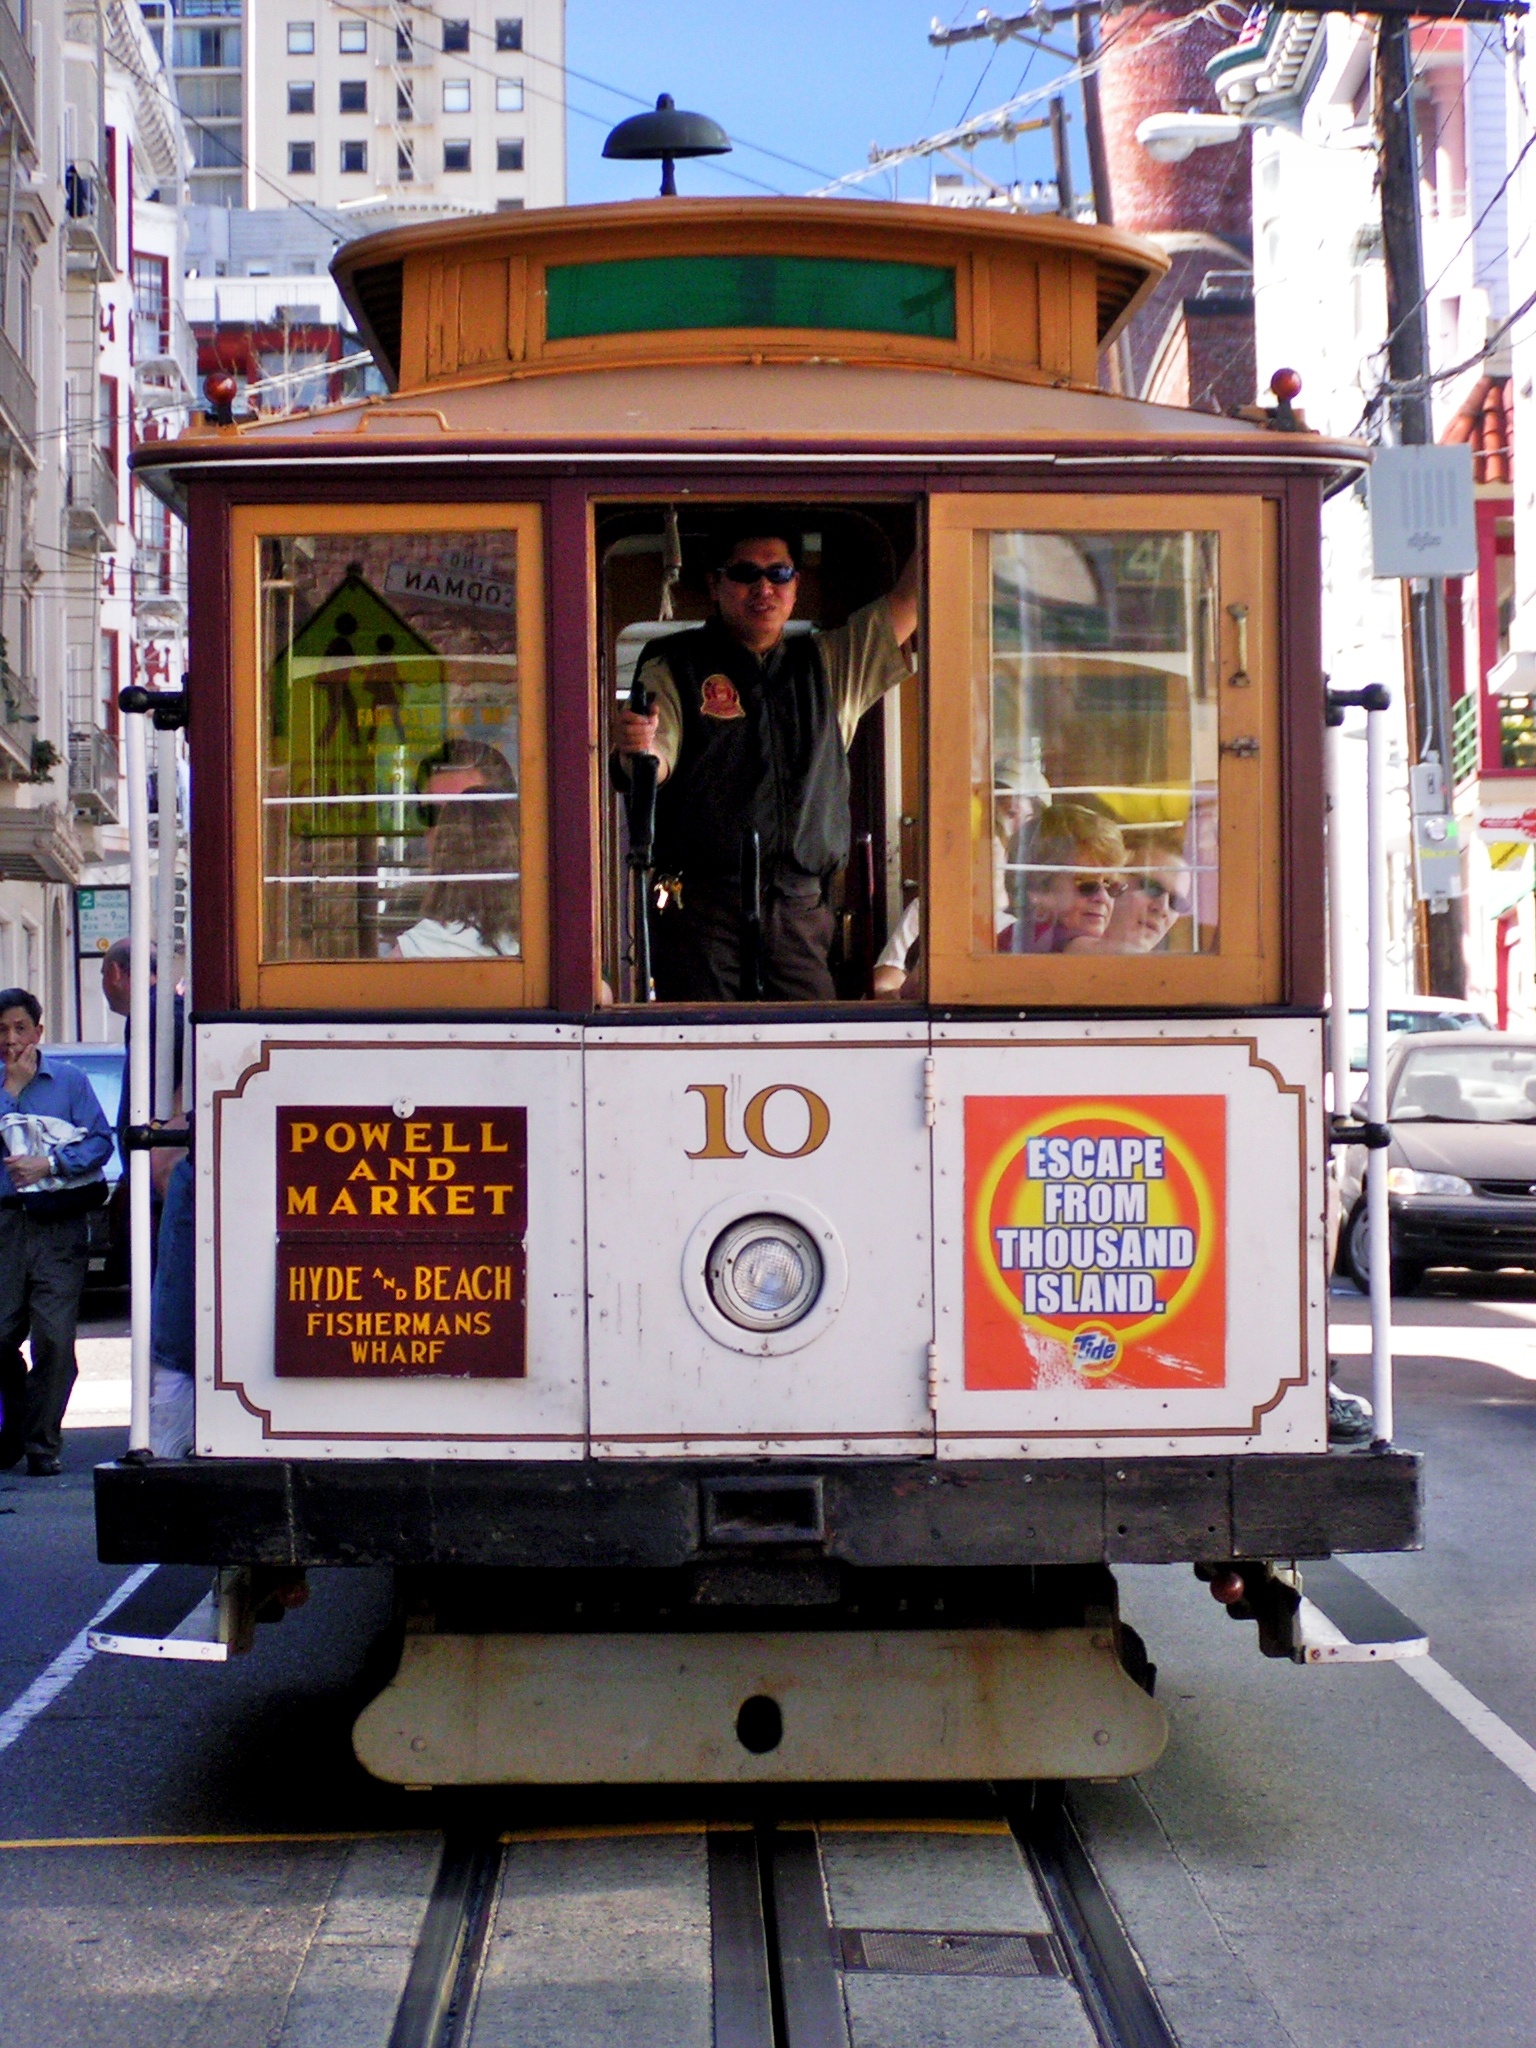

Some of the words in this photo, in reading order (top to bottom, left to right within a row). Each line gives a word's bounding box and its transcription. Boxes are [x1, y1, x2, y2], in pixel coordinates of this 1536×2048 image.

[80, 892, 93, 907] 2
[684, 1083, 831, 1159] 10
[289, 1122, 509, 1153] POWELL
[347, 1157, 457, 1181] AND
[1027, 1136, 1165, 1180] ESCAPE
[286, 1185, 514, 1215] MARKET
[1044, 1182, 1148, 1224] FROM
[995, 1227, 1196, 1270] THOUSAND
[288, 1266, 363, 1301] HYDE
[372, 1267, 407, 1301] AND
[414, 1265, 512, 1300] BEACH
[1023, 1272, 1166, 1315] ISLAND.
[307, 1312, 492, 1336] FISHERMANS
[351, 1341, 446, 1364] WHARF
[1073, 1333, 1117, 1361] Tide
